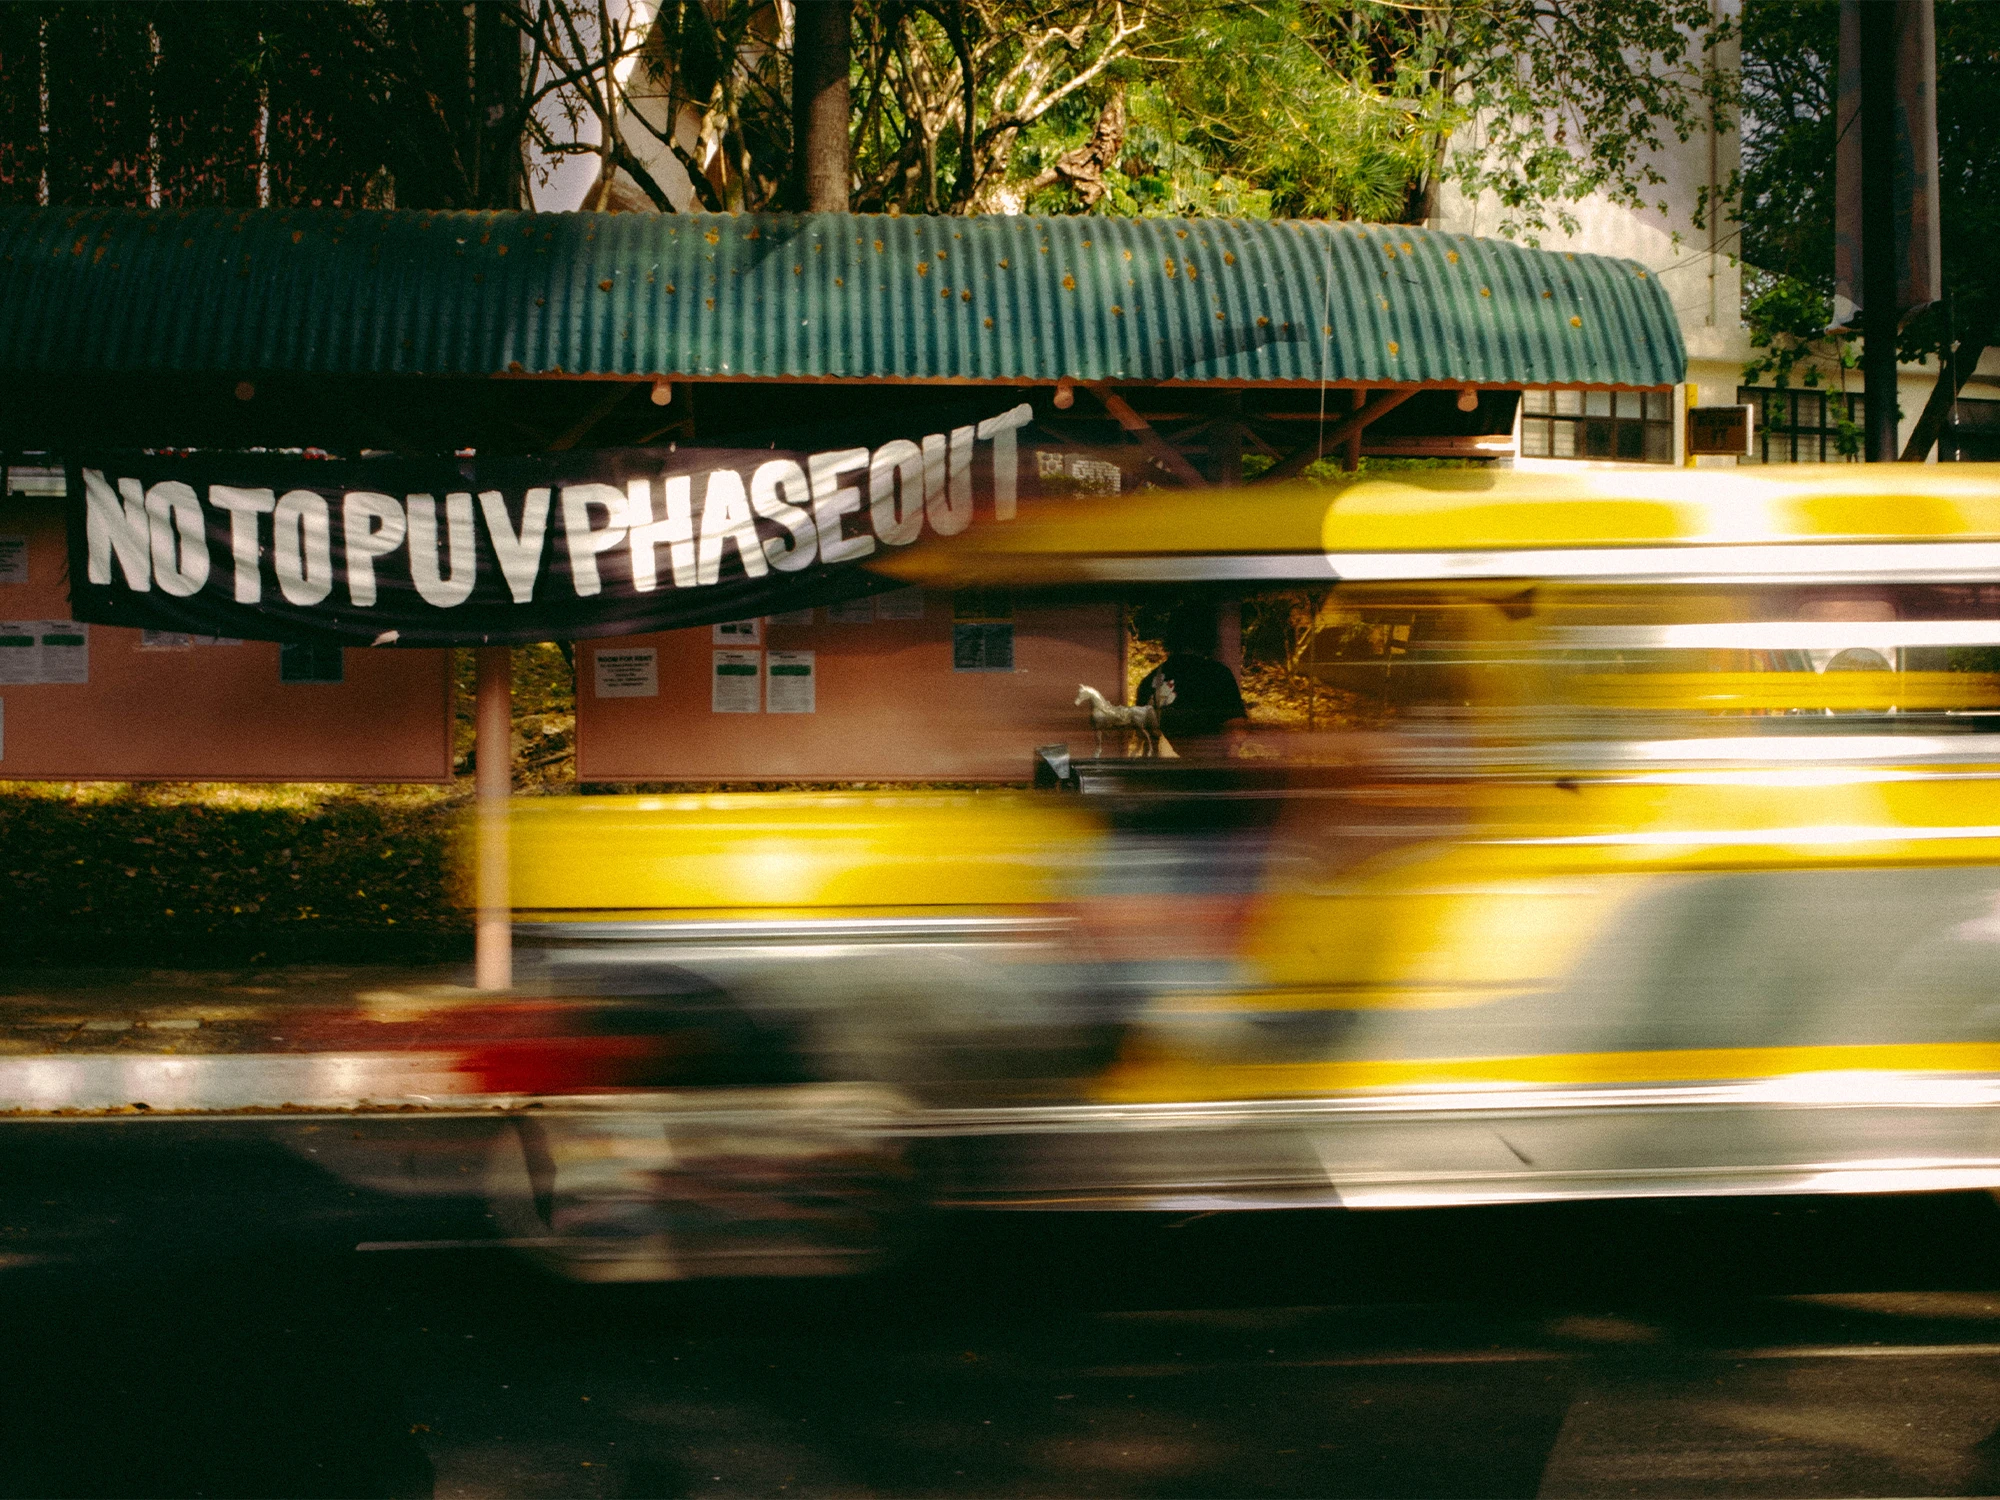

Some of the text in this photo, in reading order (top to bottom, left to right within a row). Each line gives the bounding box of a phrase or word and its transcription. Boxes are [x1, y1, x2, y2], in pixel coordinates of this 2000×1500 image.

[83, 468, 210, 597] NO
[209, 485, 333, 606] TO
[342, 488, 551, 608] PUV
